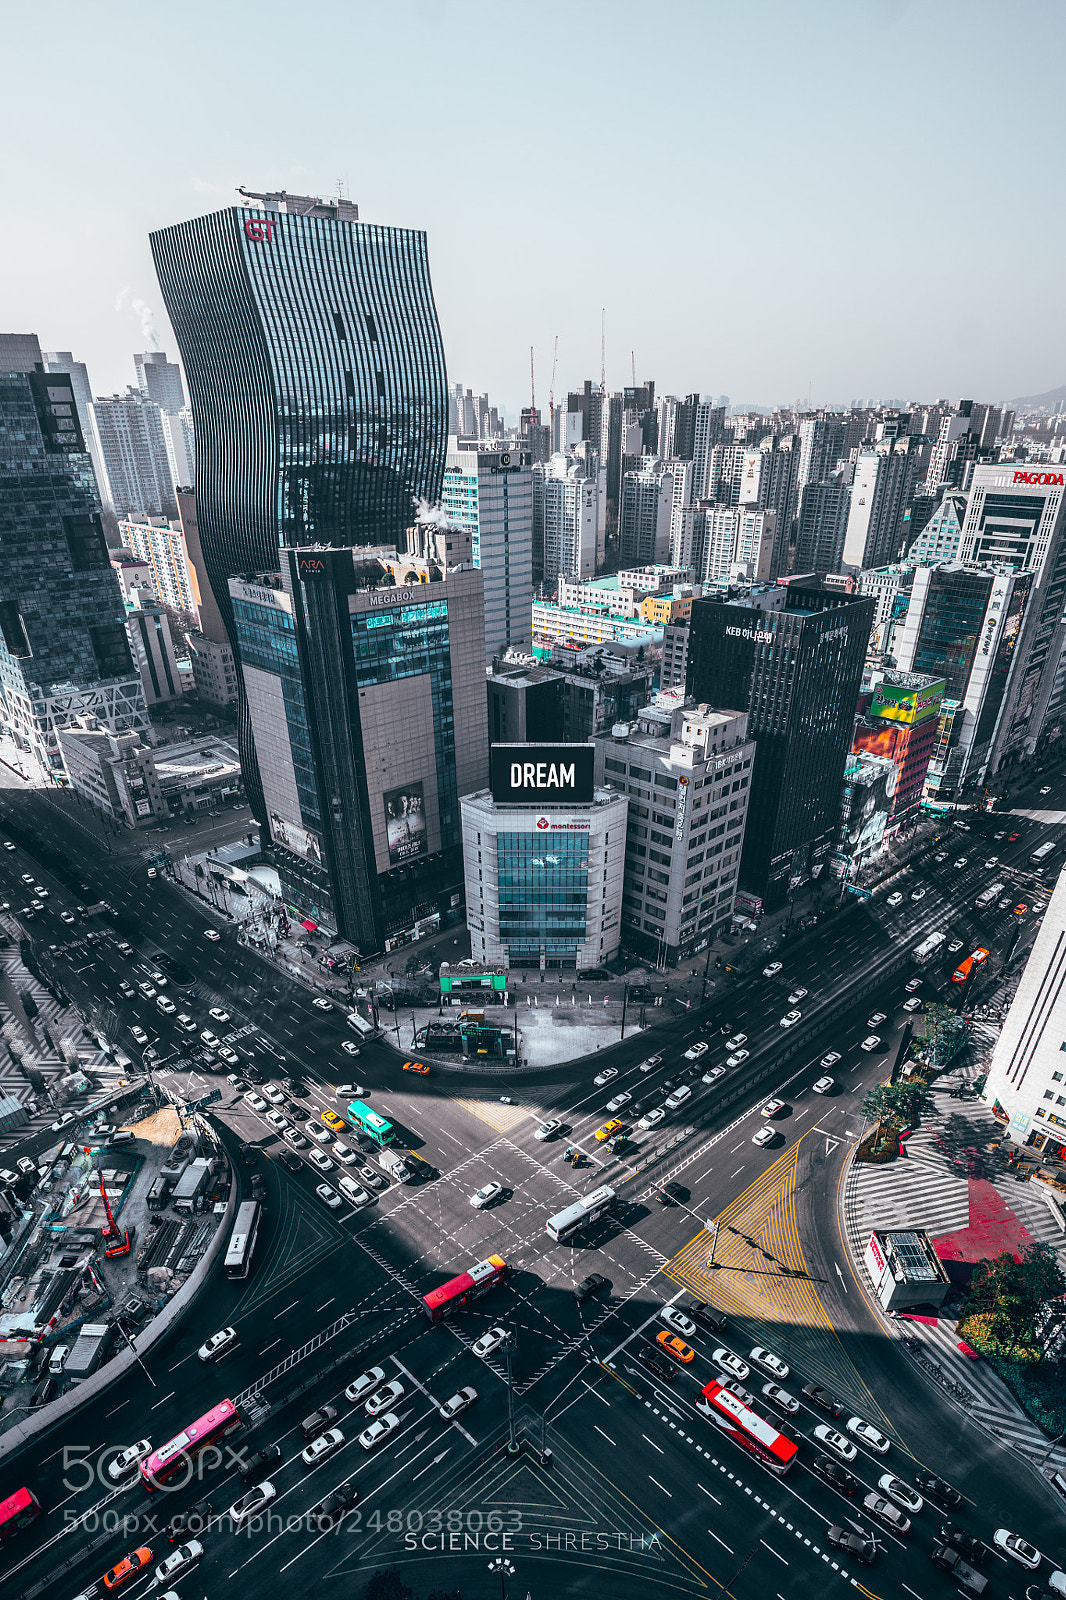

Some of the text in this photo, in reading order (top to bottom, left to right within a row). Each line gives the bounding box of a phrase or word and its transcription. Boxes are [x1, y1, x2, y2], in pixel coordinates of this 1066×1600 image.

[246, 218, 277, 242] GT
[1012, 471, 1065, 486] PAGODA
[300, 559, 325, 569] ARA
[369, 591, 415, 606] MEGABOX
[725, 625, 773, 644] KEB 하나은행
[510, 763, 575, 788] DREAM
